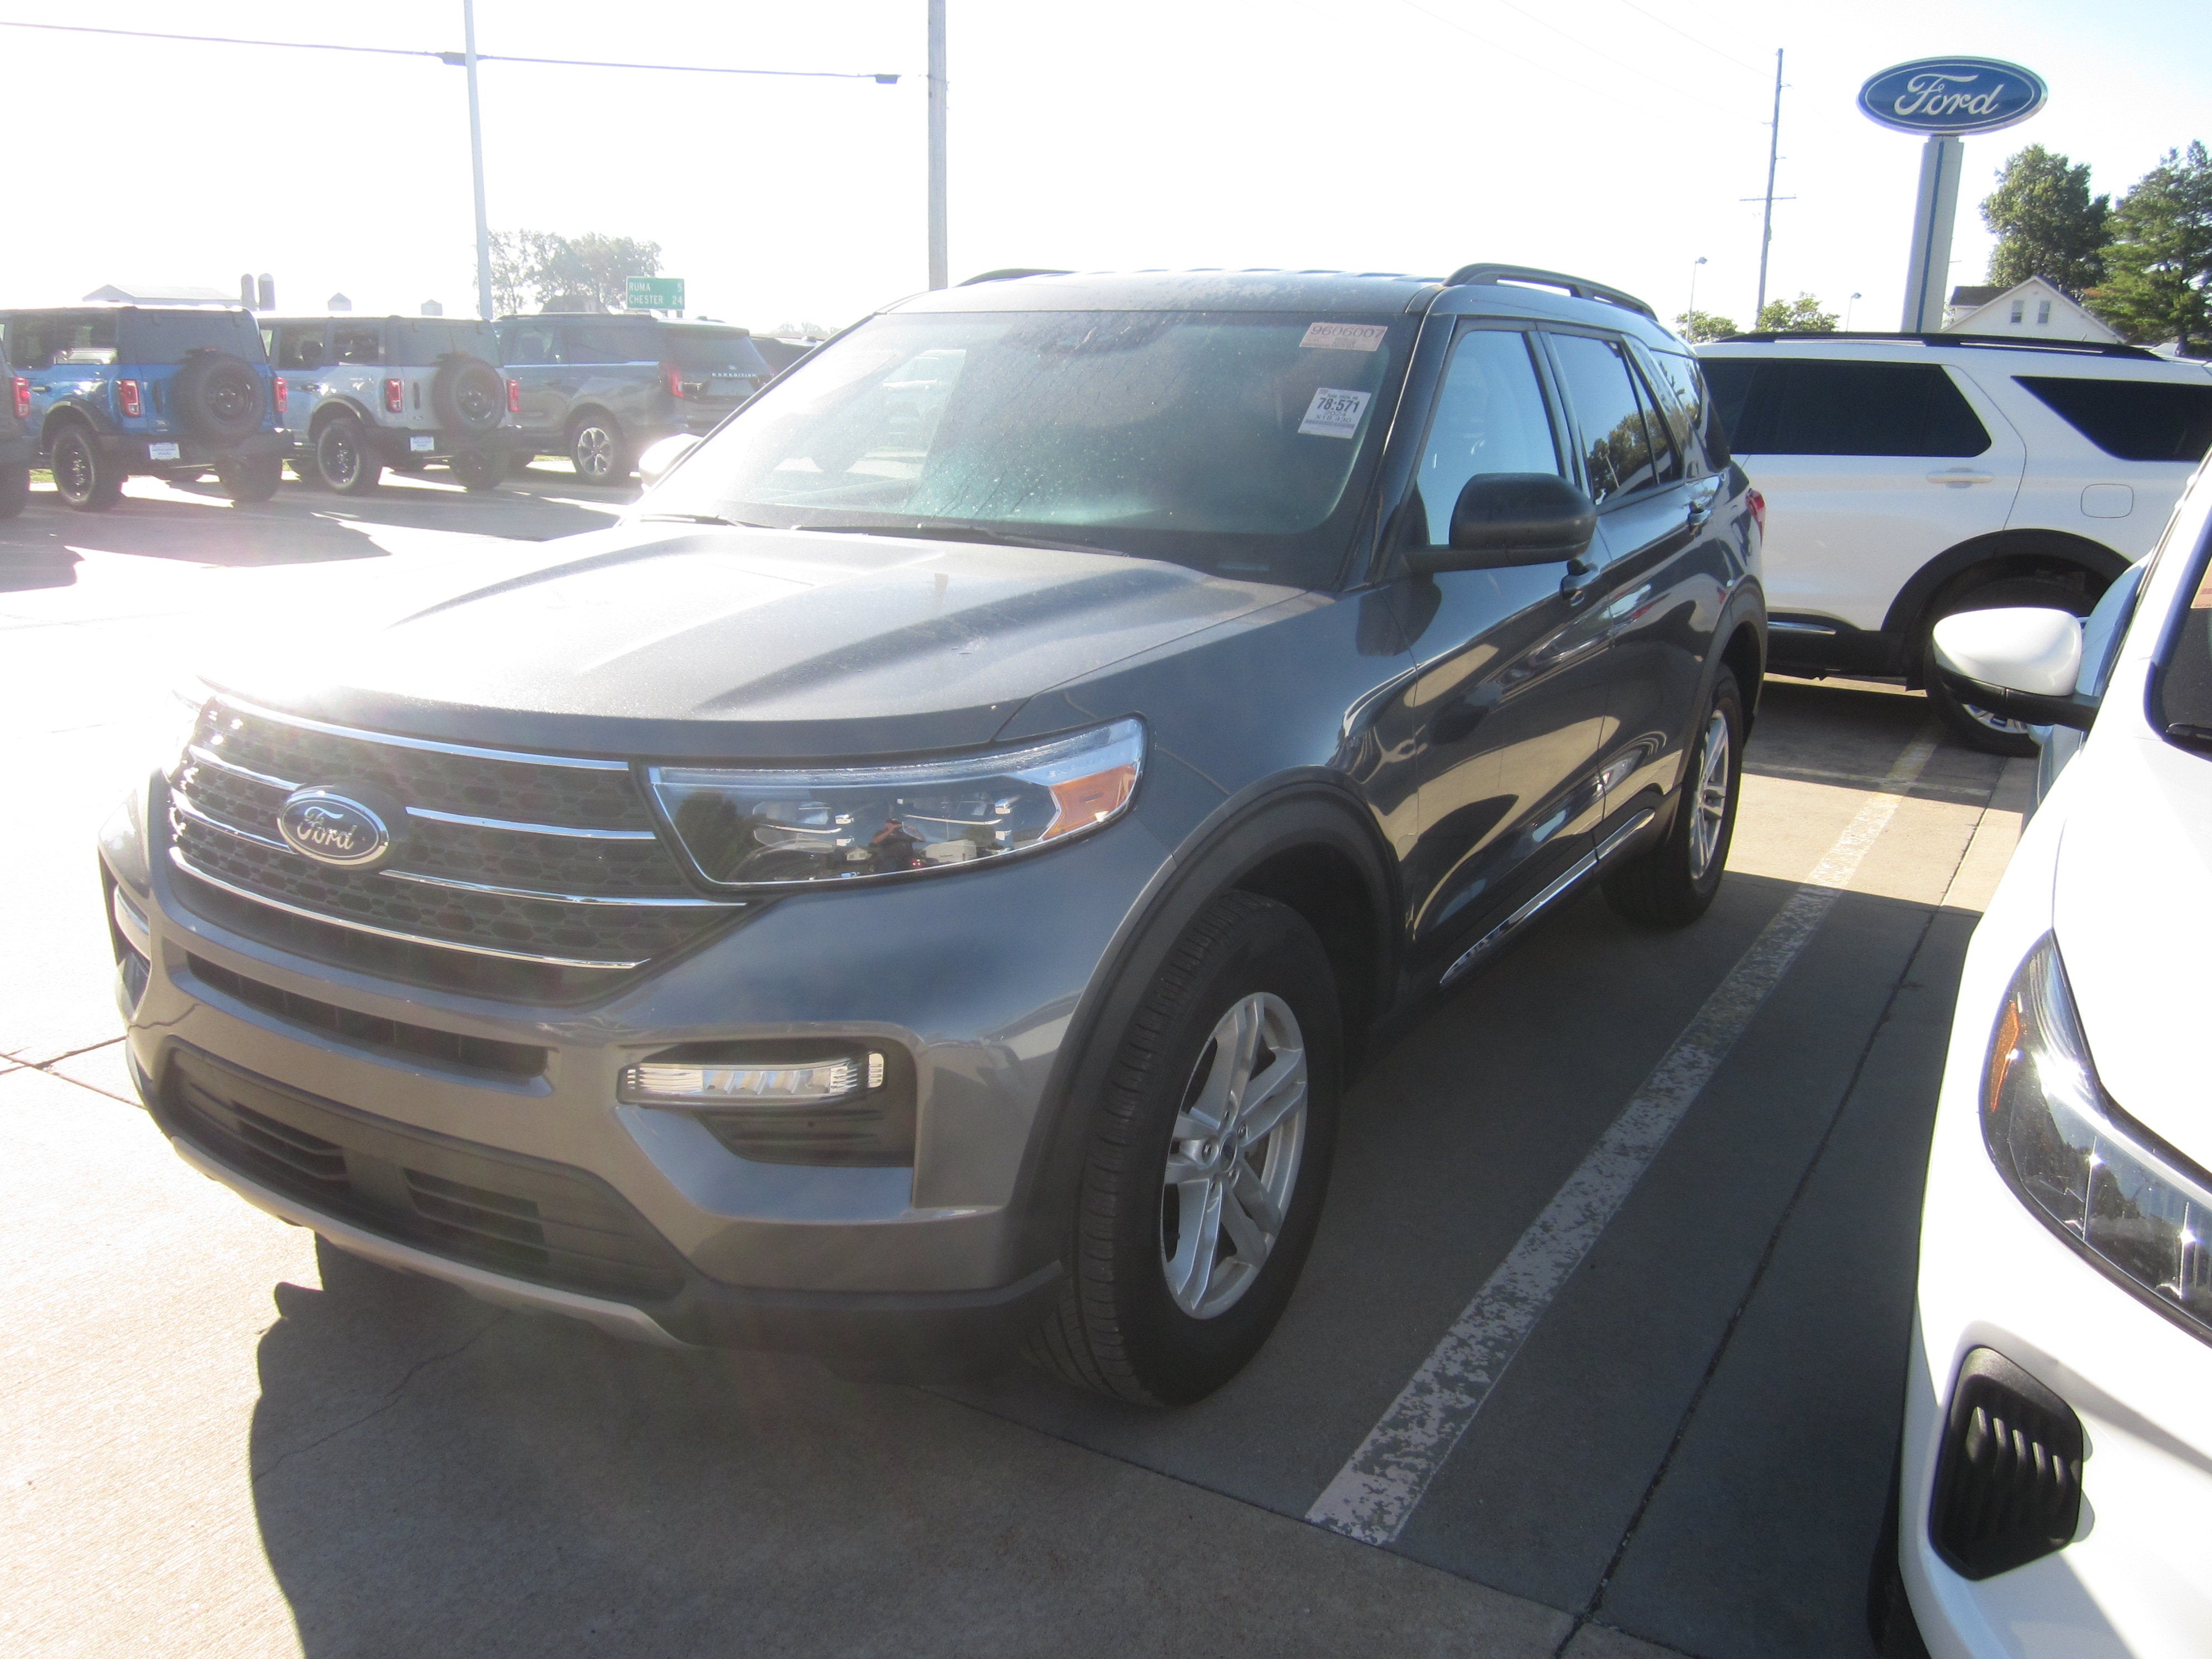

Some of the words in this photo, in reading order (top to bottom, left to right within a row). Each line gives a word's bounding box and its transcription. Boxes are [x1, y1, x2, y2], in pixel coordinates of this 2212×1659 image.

[1894, 74, 2005, 116] Ford
[629, 283, 651, 292] RUMA
[677, 283, 683, 293] 5
[629, 295, 664, 305] CHESTER
[672, 295, 682, 305] 24
[1317, 398, 1360, 413] 78:571
[297, 806, 358, 850] Ford
